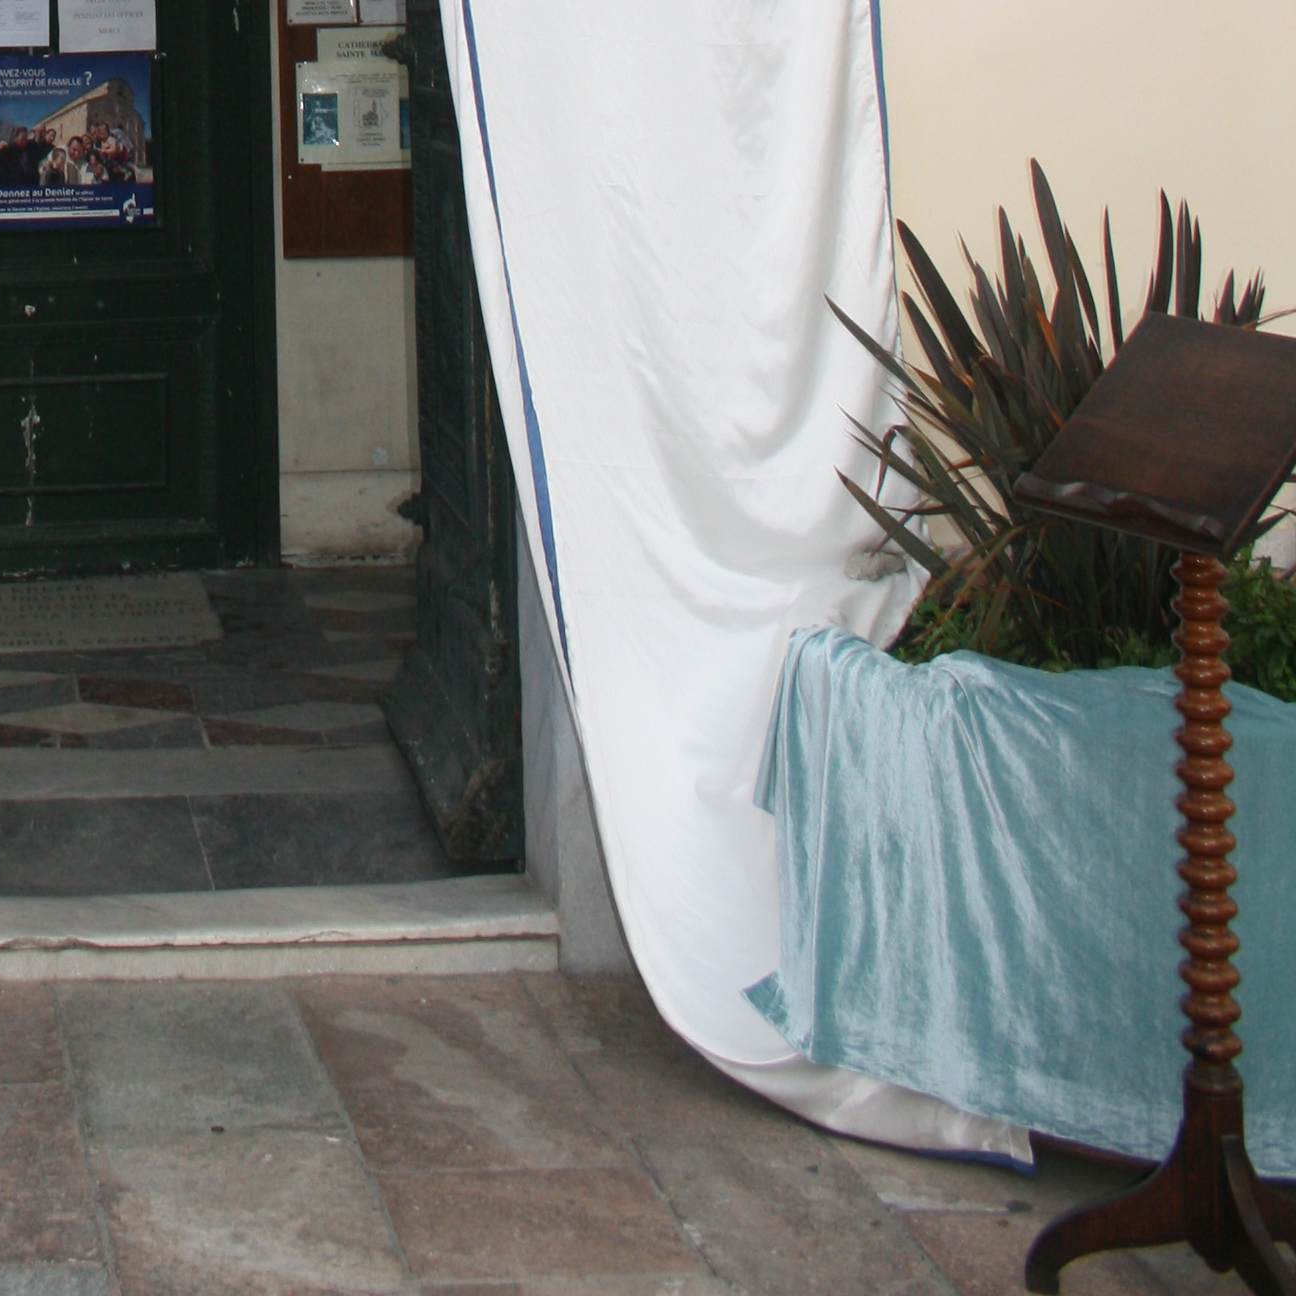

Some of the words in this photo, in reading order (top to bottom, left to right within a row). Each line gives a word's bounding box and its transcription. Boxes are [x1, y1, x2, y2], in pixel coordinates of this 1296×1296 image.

[35, 78, 46, 87] DE
[47, 77, 82, 86] FAMILLE
[45, 187, 75, 197] Denier
